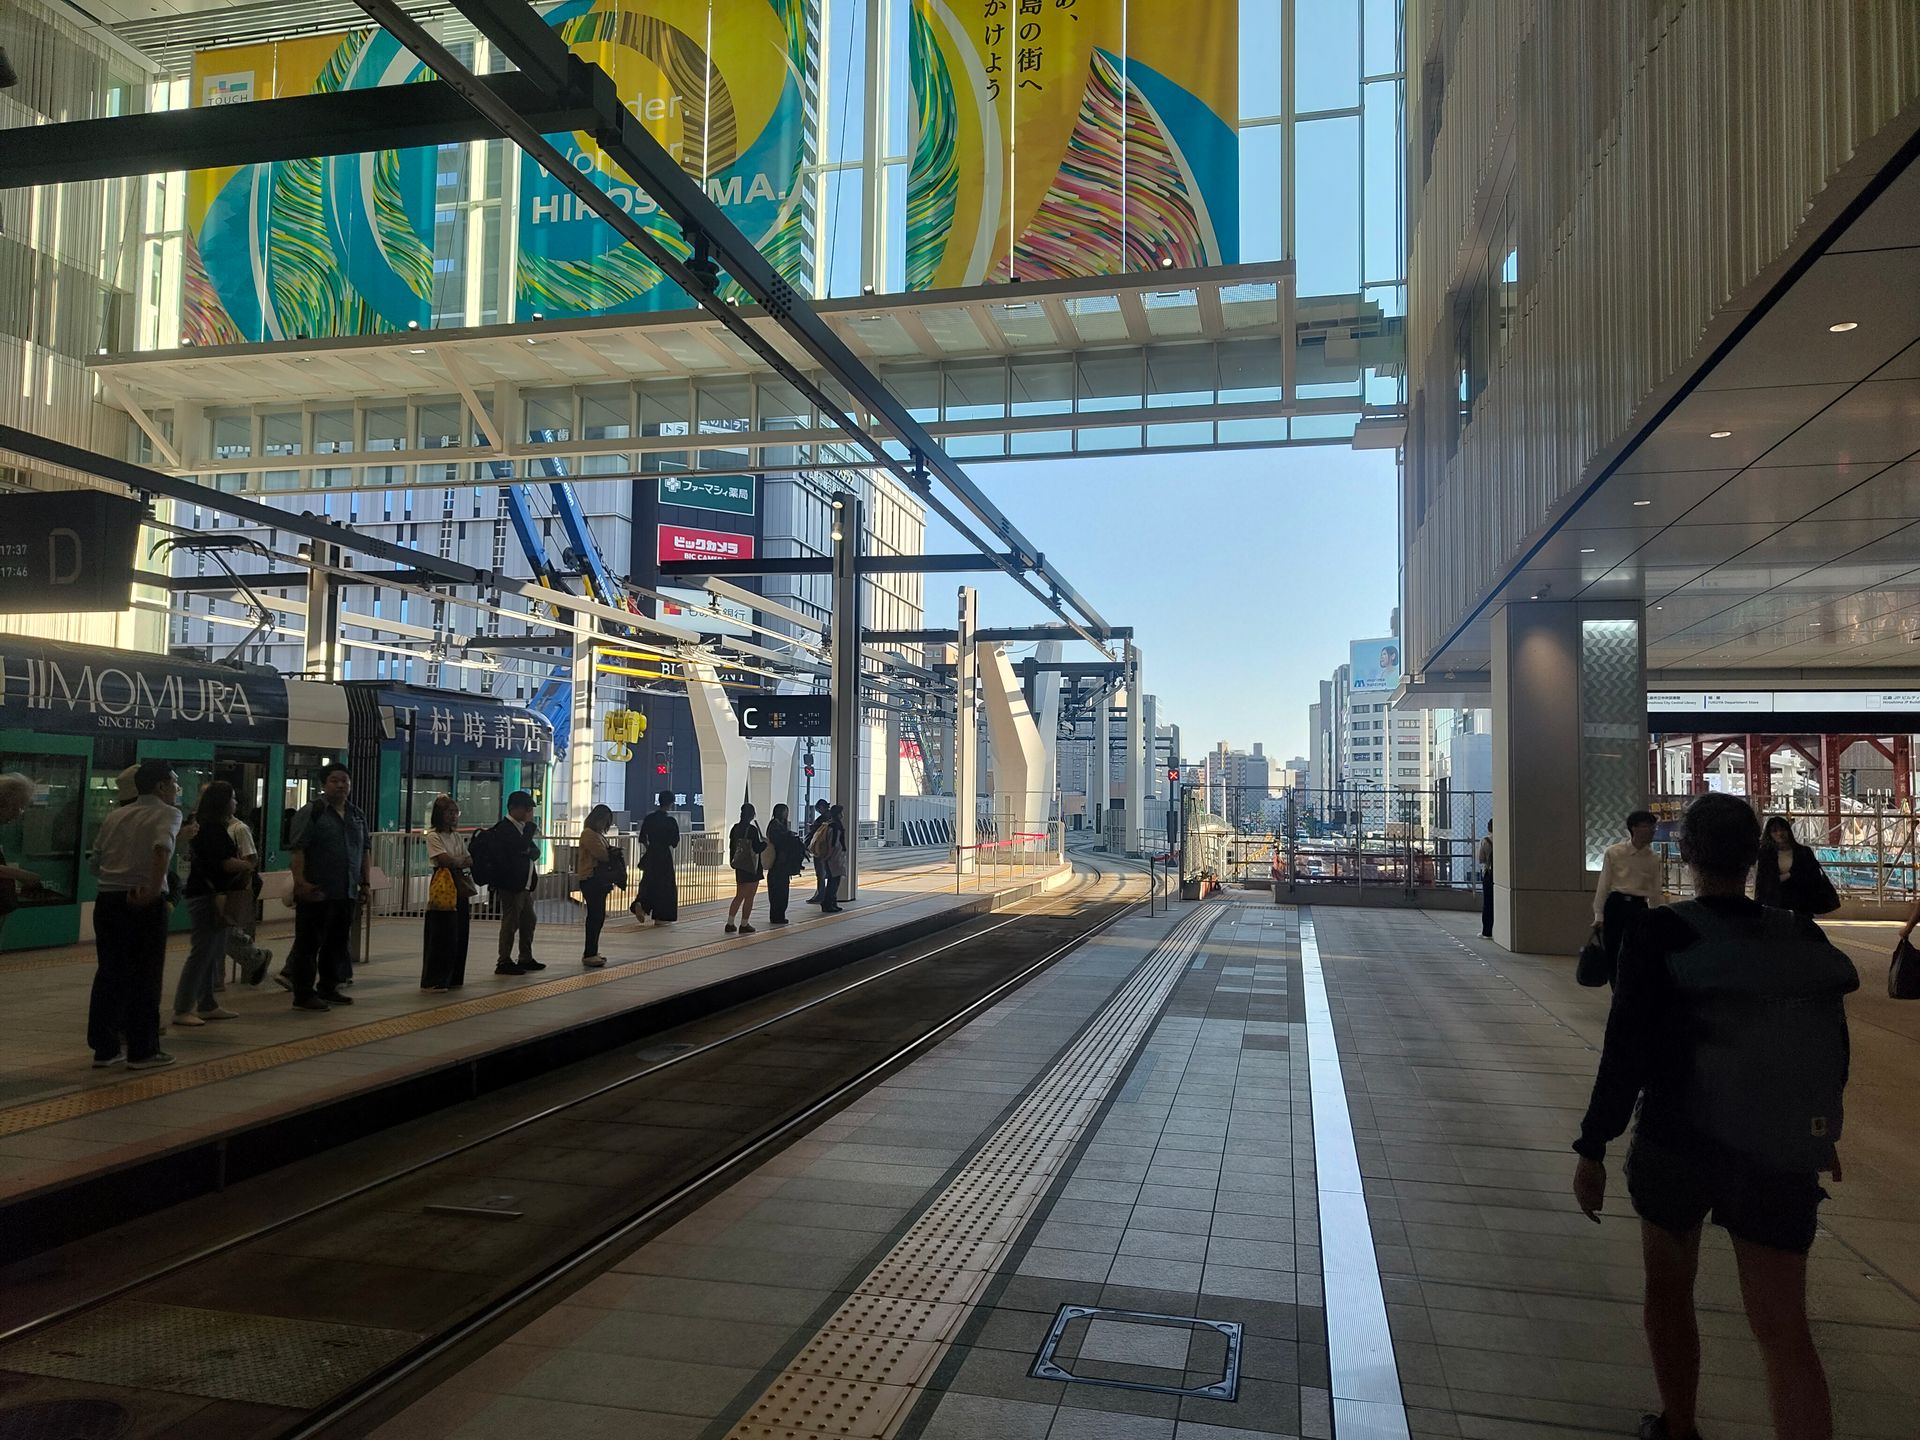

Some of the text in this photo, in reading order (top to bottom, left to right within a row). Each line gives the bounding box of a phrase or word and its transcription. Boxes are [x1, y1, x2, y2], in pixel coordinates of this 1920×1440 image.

[208, 94, 248, 105] TOUCH
[623, 93, 690, 122] der.
[532, 172, 786, 225] HIROSMA.
[0, 544, 27, 556] 17:37
[674, 535, 738, 554] ビックカメラ
[48, 527, 82, 585] D
[98, 714, 155, 731] SINCE 1873
[394, 705, 541, 753] 下村時計店
[743, 707, 758, 729] C
